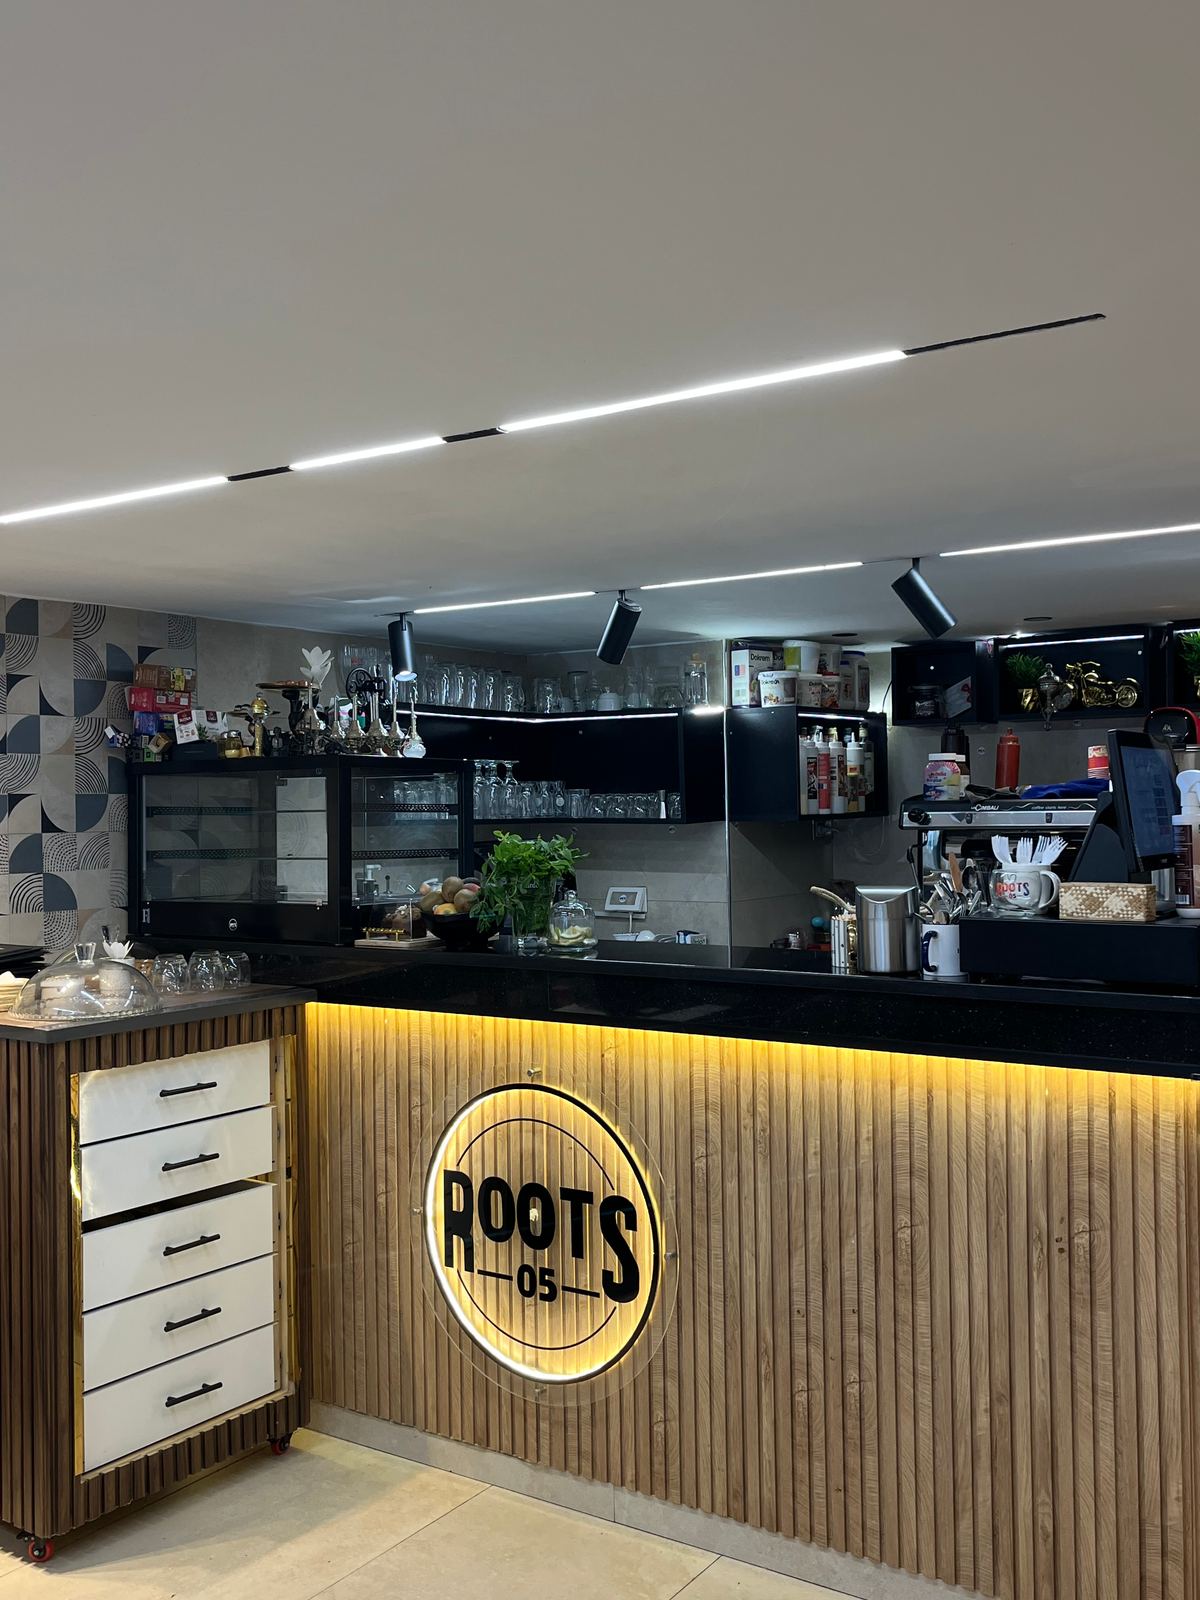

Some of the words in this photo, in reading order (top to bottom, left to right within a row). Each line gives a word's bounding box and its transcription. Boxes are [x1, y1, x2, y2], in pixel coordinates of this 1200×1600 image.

[995, 881, 1029, 896] ROOTS
[444, 1169, 640, 1303] ROOTS
[444, 1169, 639, 1303] 05
